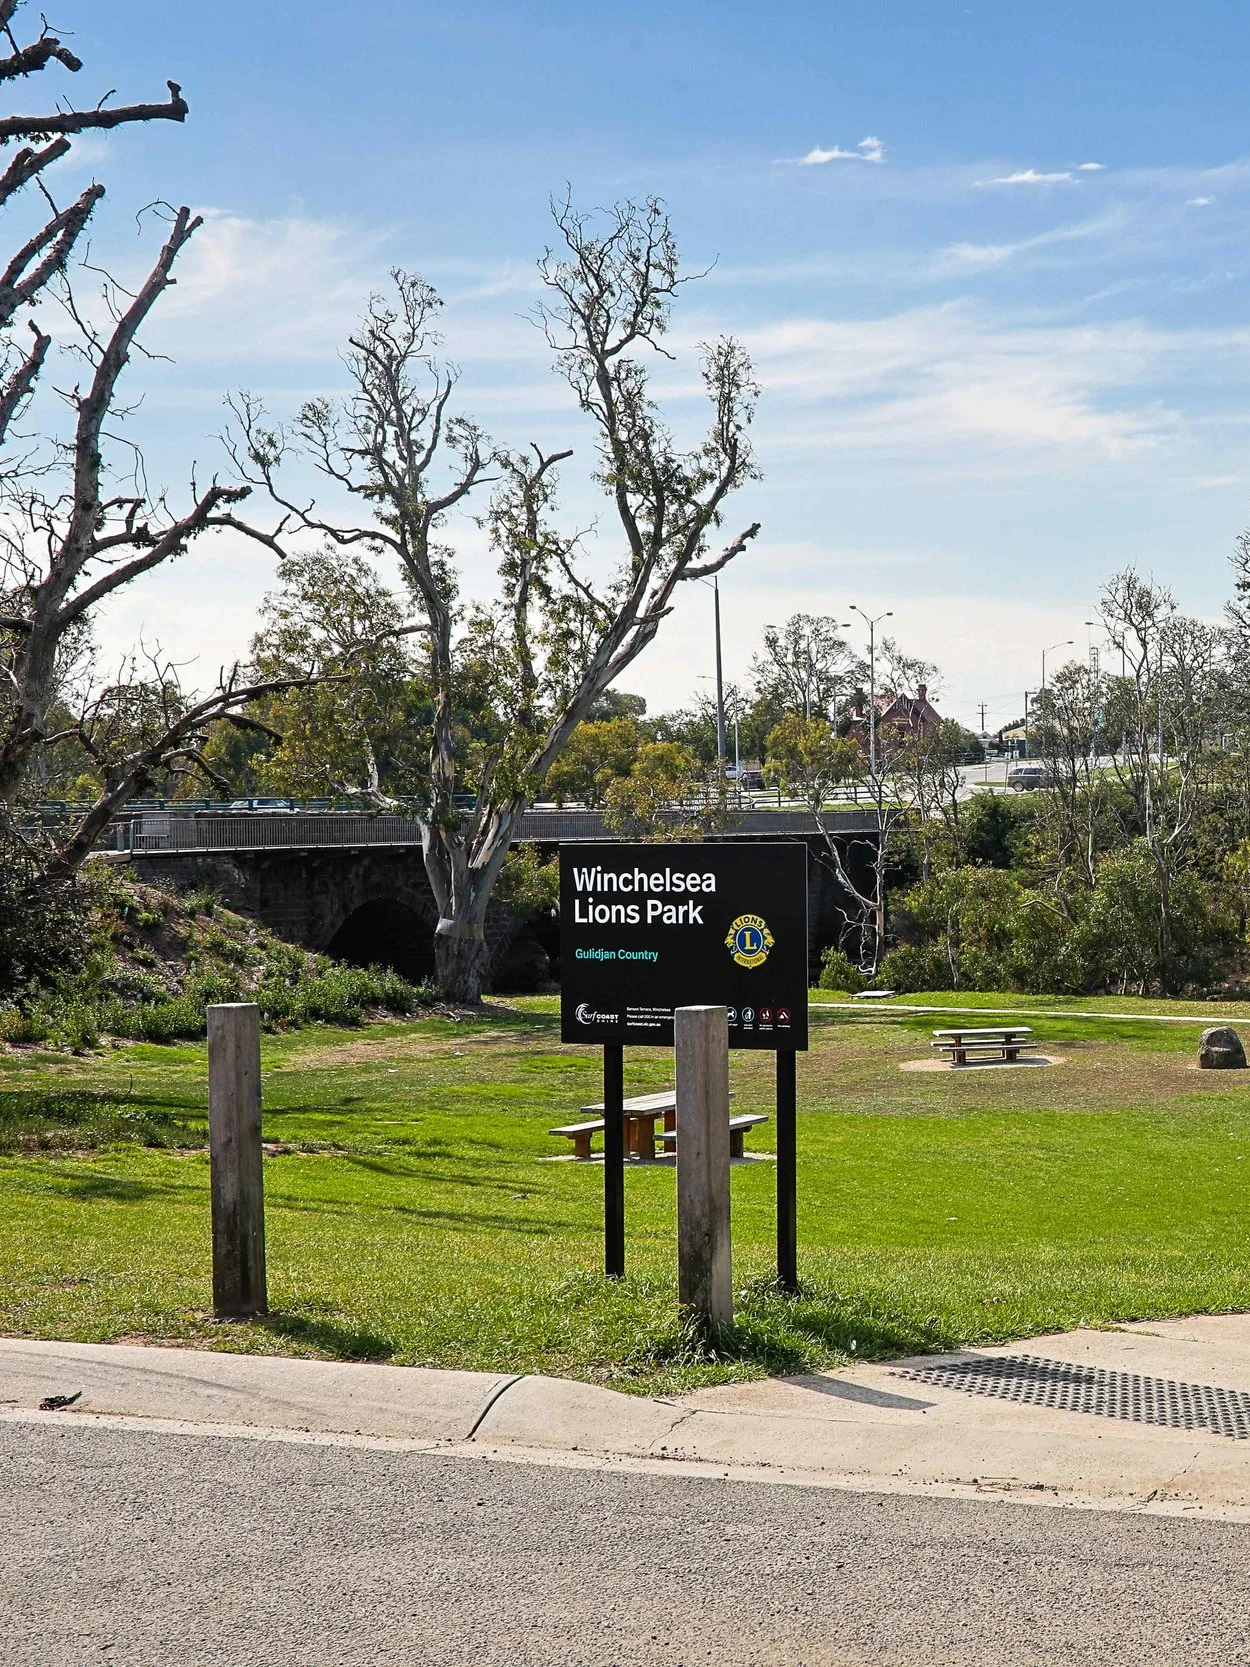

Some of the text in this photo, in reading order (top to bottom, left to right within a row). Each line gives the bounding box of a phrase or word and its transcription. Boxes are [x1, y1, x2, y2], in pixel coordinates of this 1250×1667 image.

[573, 866, 716, 893] Winchelsea
[574, 897, 704, 925] Lions Park
[734, 916, 764, 929] LIONS
[743, 931, 757, 950] L
[575, 948, 659, 962] Gulidjan Country
[582, 1010, 597, 1022] Surf
